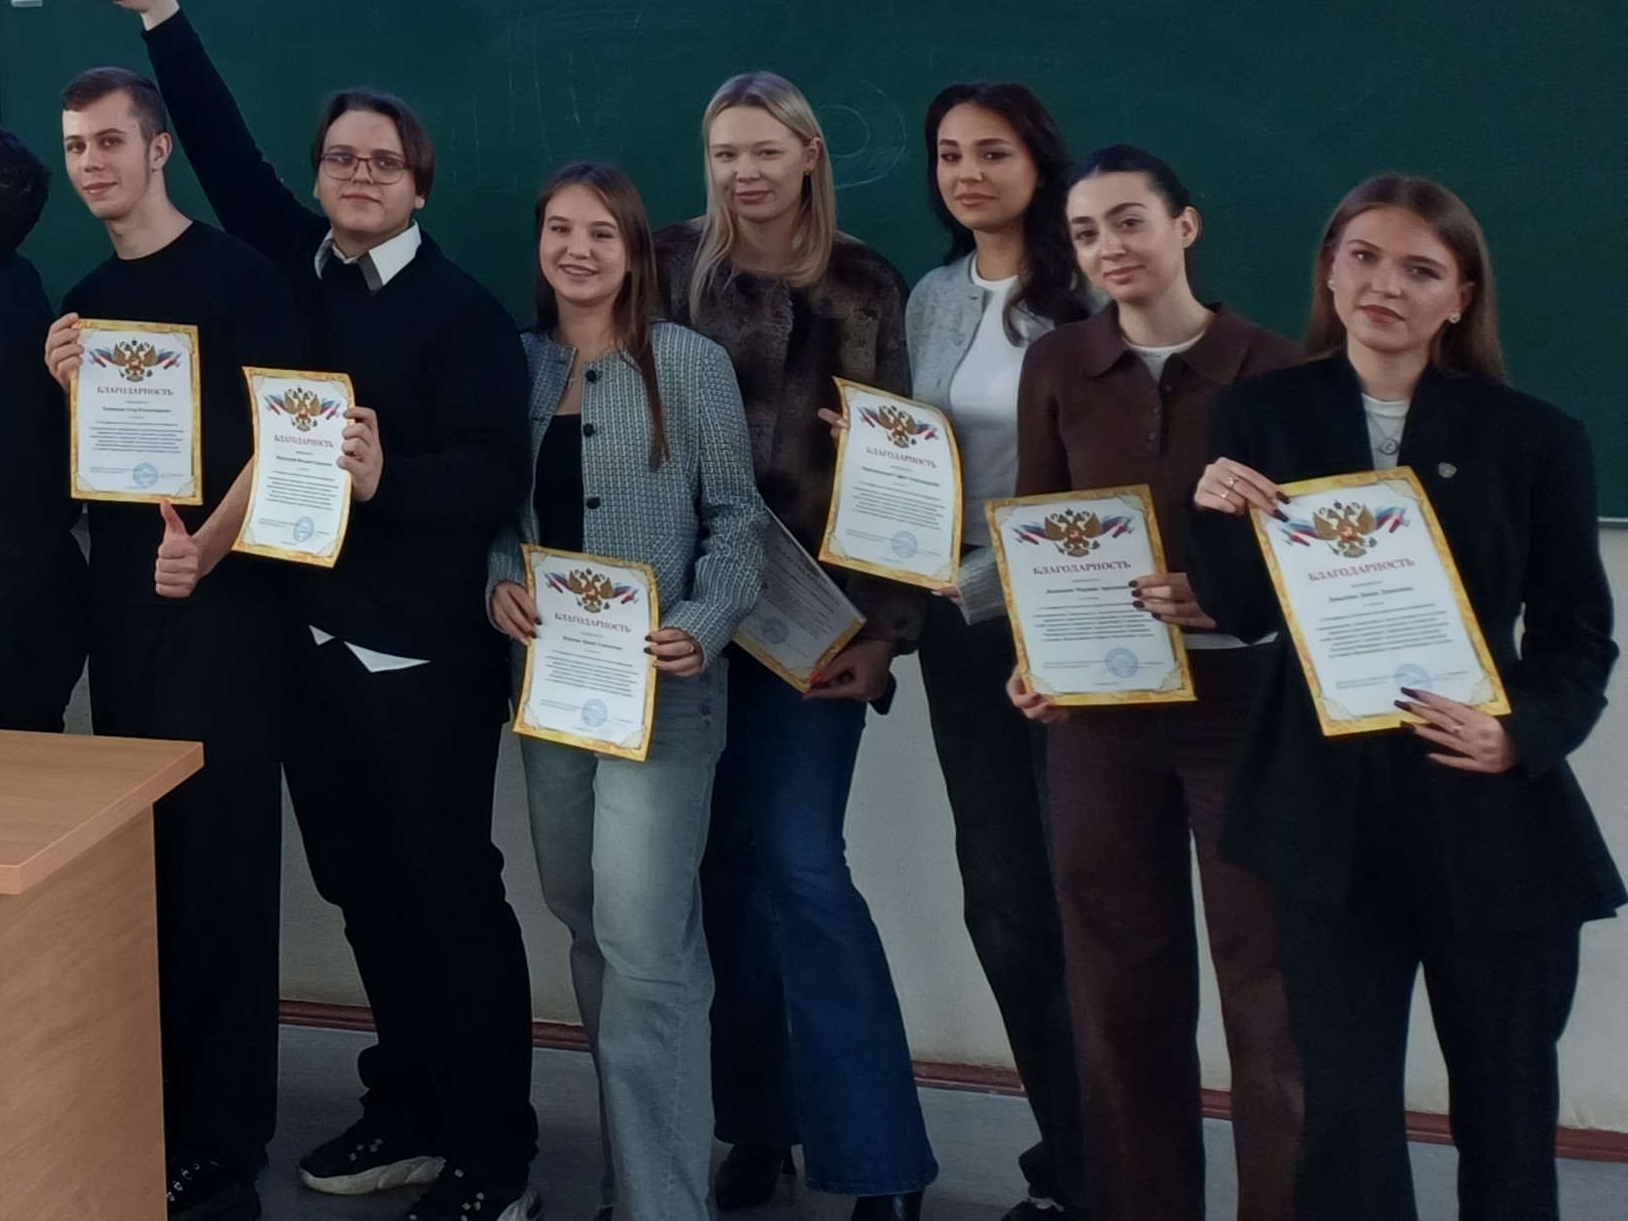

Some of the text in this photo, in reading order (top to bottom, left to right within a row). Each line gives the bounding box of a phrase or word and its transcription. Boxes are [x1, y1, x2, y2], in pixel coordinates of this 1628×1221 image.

[97, 386, 174, 396] БЛАГОДАРНОСТЬ
[274, 434, 334, 448] БЛАГОДАРНОСТЬ
[866, 446, 937, 469] БЛАГОДАРНОСТЬ
[1033, 560, 1132, 575] БЛАГОДАРНОСТЬ
[1308, 558, 1415, 581] БЛАГОДАРНОСТЬ
[554, 612, 631, 633] БЛАГОДАРНОСТЬ
